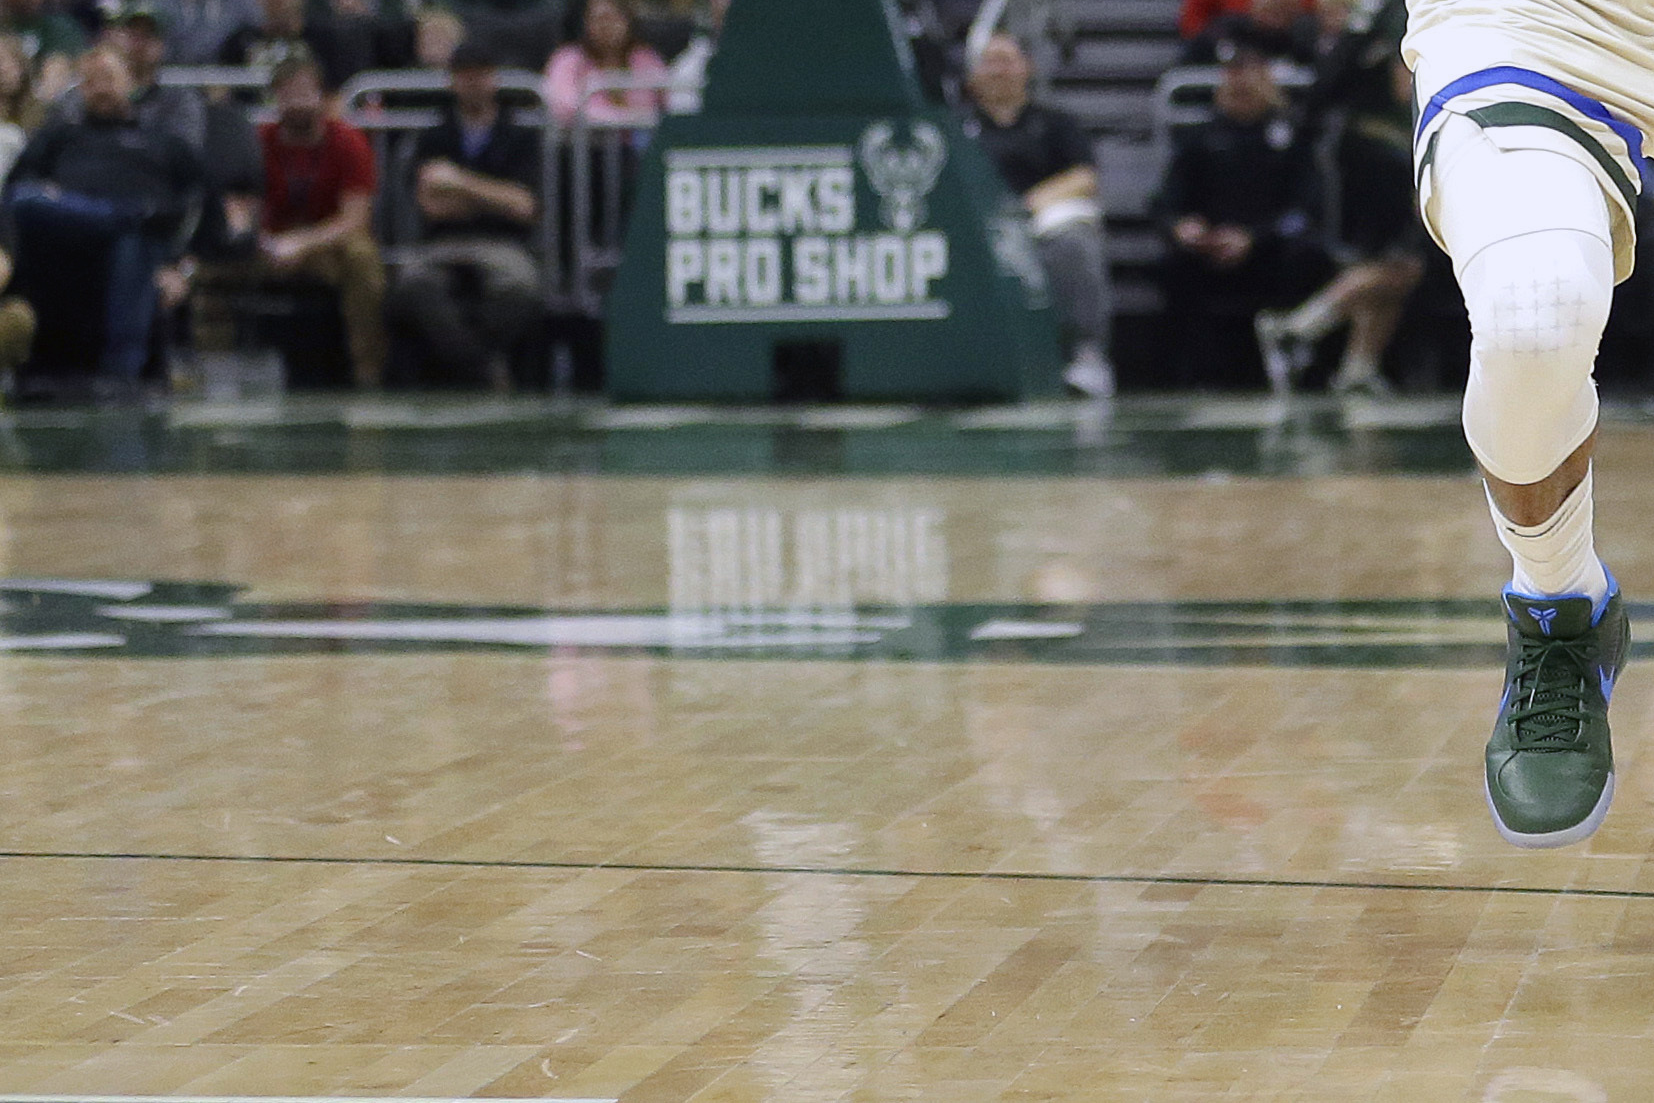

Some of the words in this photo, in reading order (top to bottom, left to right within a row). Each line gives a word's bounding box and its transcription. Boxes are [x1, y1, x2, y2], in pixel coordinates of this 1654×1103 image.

[667, 168, 855, 234] BUCKS
[667, 238, 781, 306] PRO
[792, 231, 949, 305] SHOP
